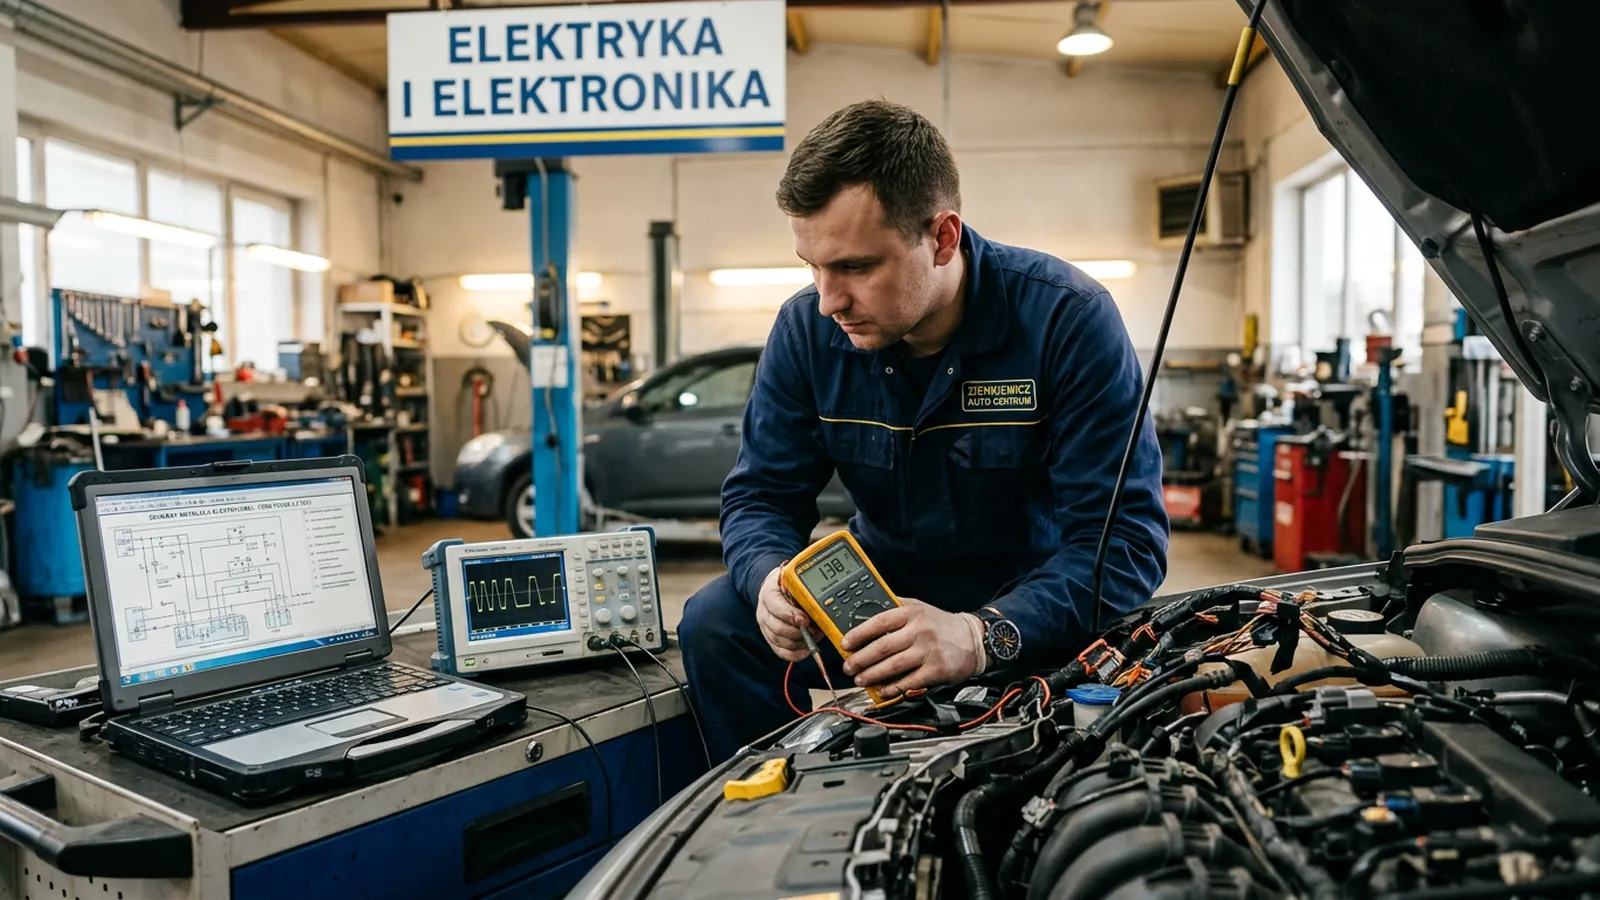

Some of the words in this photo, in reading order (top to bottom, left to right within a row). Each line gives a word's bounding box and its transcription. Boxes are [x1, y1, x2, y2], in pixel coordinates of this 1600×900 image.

[450, 18, 722, 63] ELEKTRYKA
[403, 82, 411, 117] I
[434, 70, 769, 117] ELEKTRONIKA
[967, 397, 991, 406] AUTO
